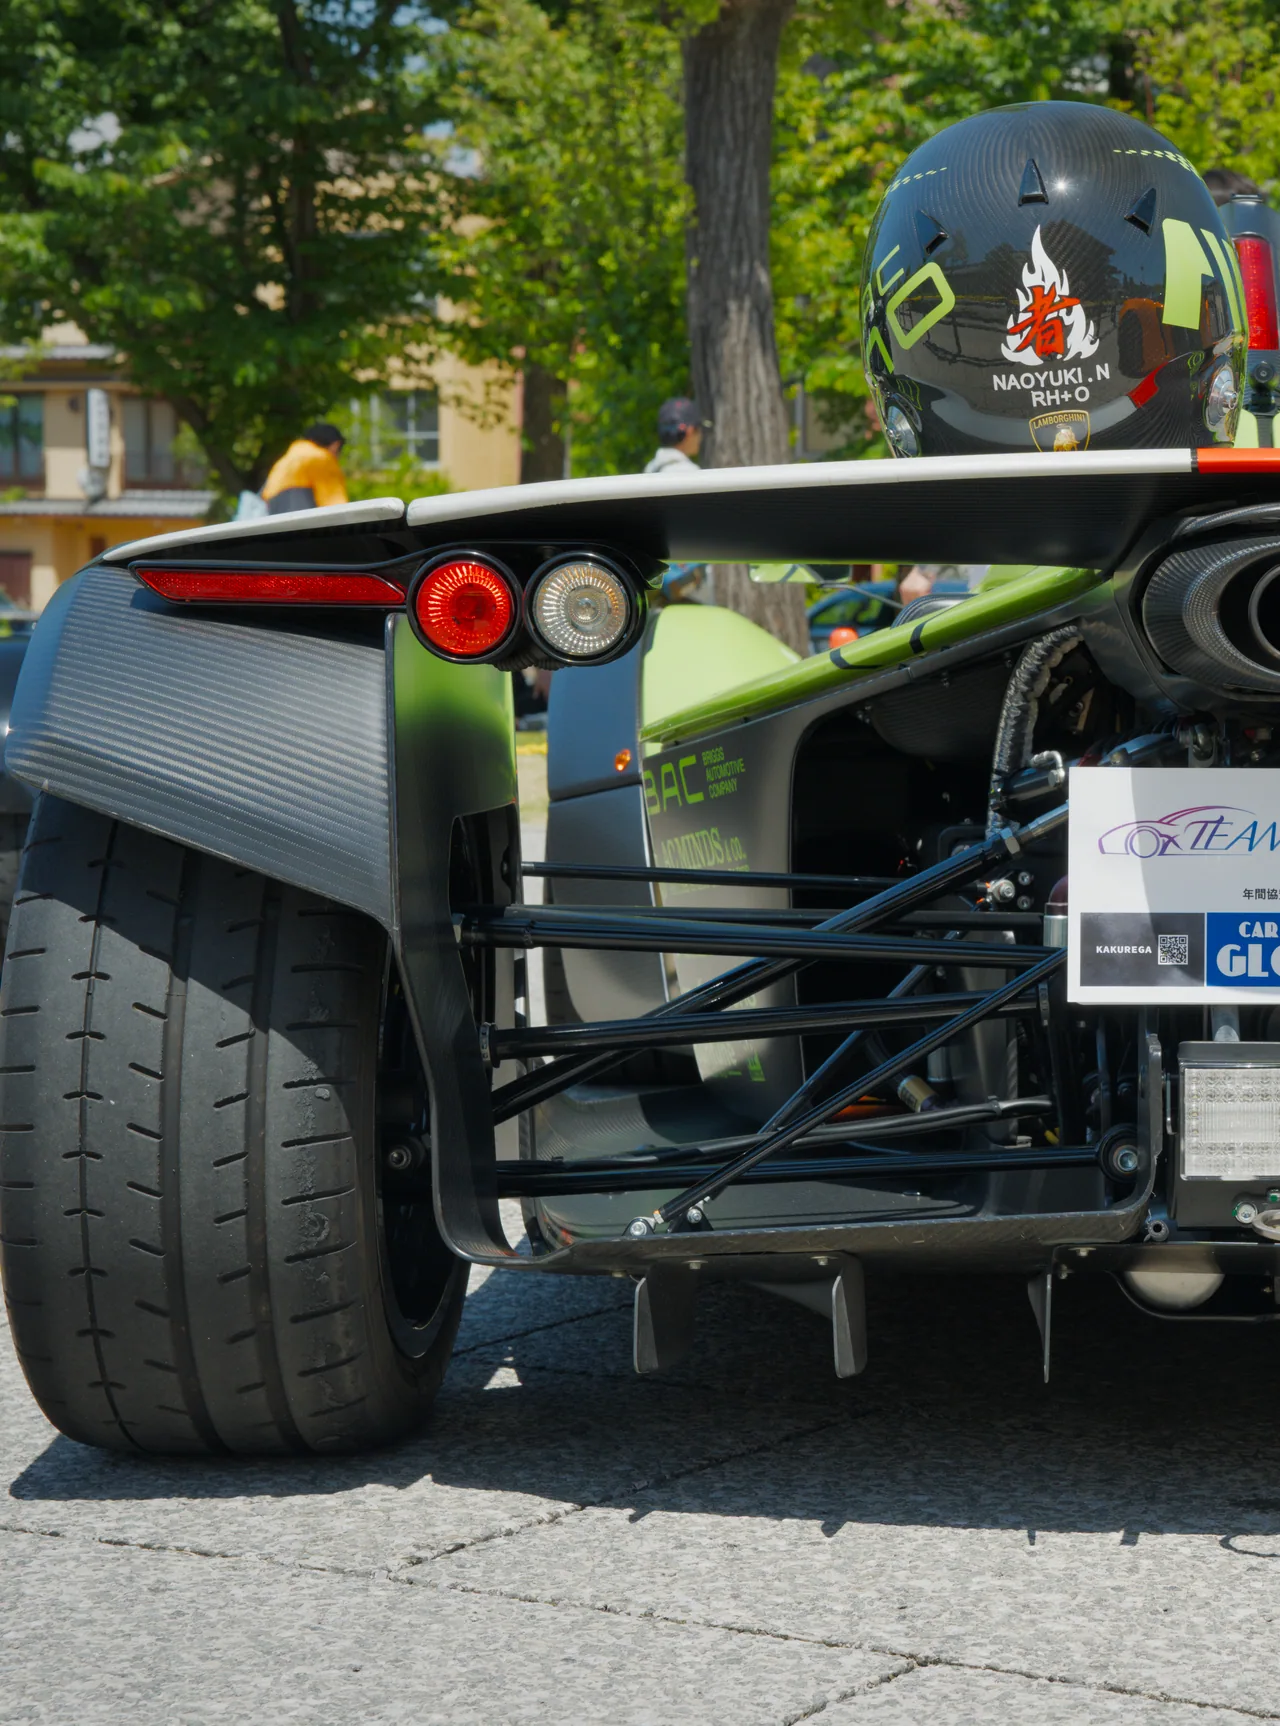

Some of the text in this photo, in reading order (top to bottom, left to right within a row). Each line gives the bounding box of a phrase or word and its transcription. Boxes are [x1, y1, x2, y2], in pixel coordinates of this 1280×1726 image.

[1008, 282, 1081, 357] 者
[1033, 413, 1086, 430] LAMBORGHINI
[706, 758, 745, 782] AUTOMOTIVE
[709, 778, 738, 799] COMPANY
[1238, 921, 1279, 938] CAR
[1096, 945, 1152, 954] KAKUREGA
